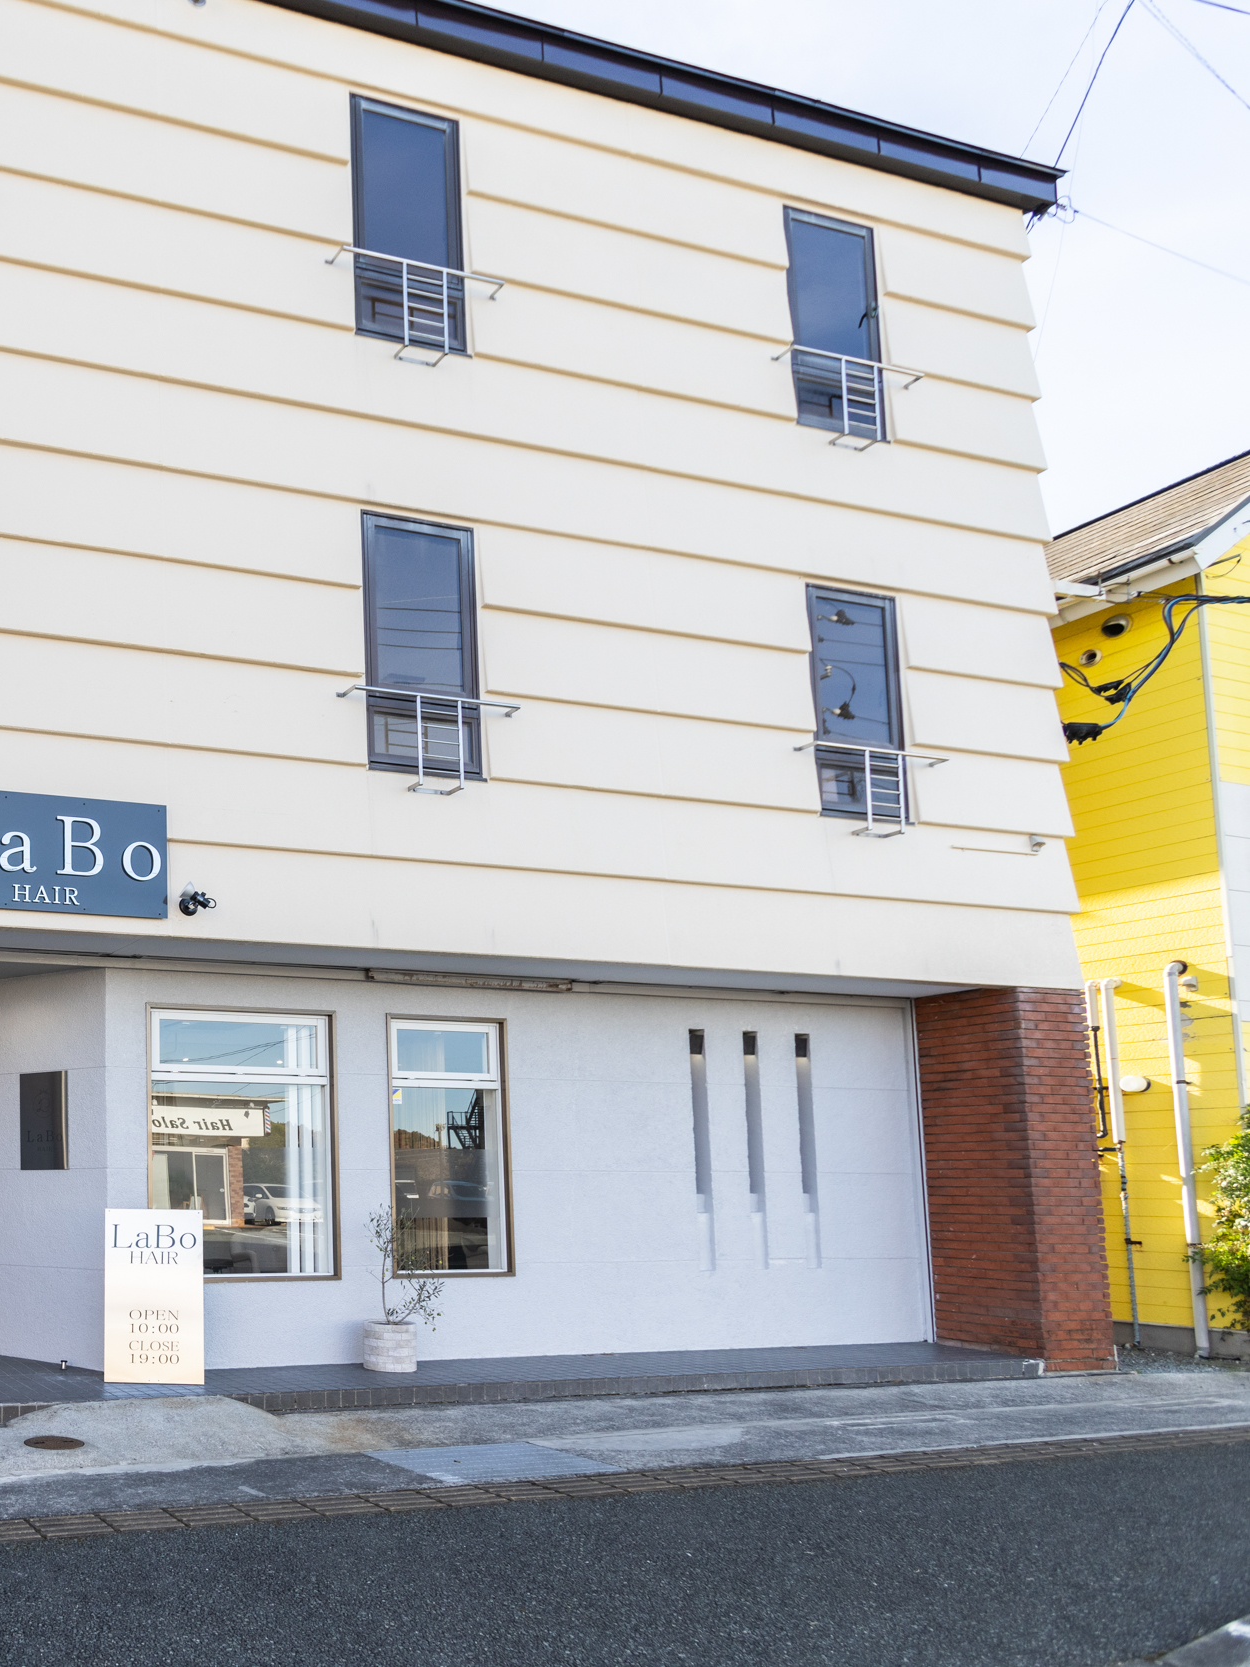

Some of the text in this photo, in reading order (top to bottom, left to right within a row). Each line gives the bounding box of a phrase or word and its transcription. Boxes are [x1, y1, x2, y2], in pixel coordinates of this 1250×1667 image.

[12, 883, 80, 906] HAIR
[111, 1223, 197, 1249] LaBo
[130, 1251, 178, 1265] HAIR
[129, 1309, 180, 1321] OPEN
[130, 1323, 180, 1334] 10:00
[128, 1340, 180, 1352] CLOSE
[130, 1353, 180, 1365] 19:00
